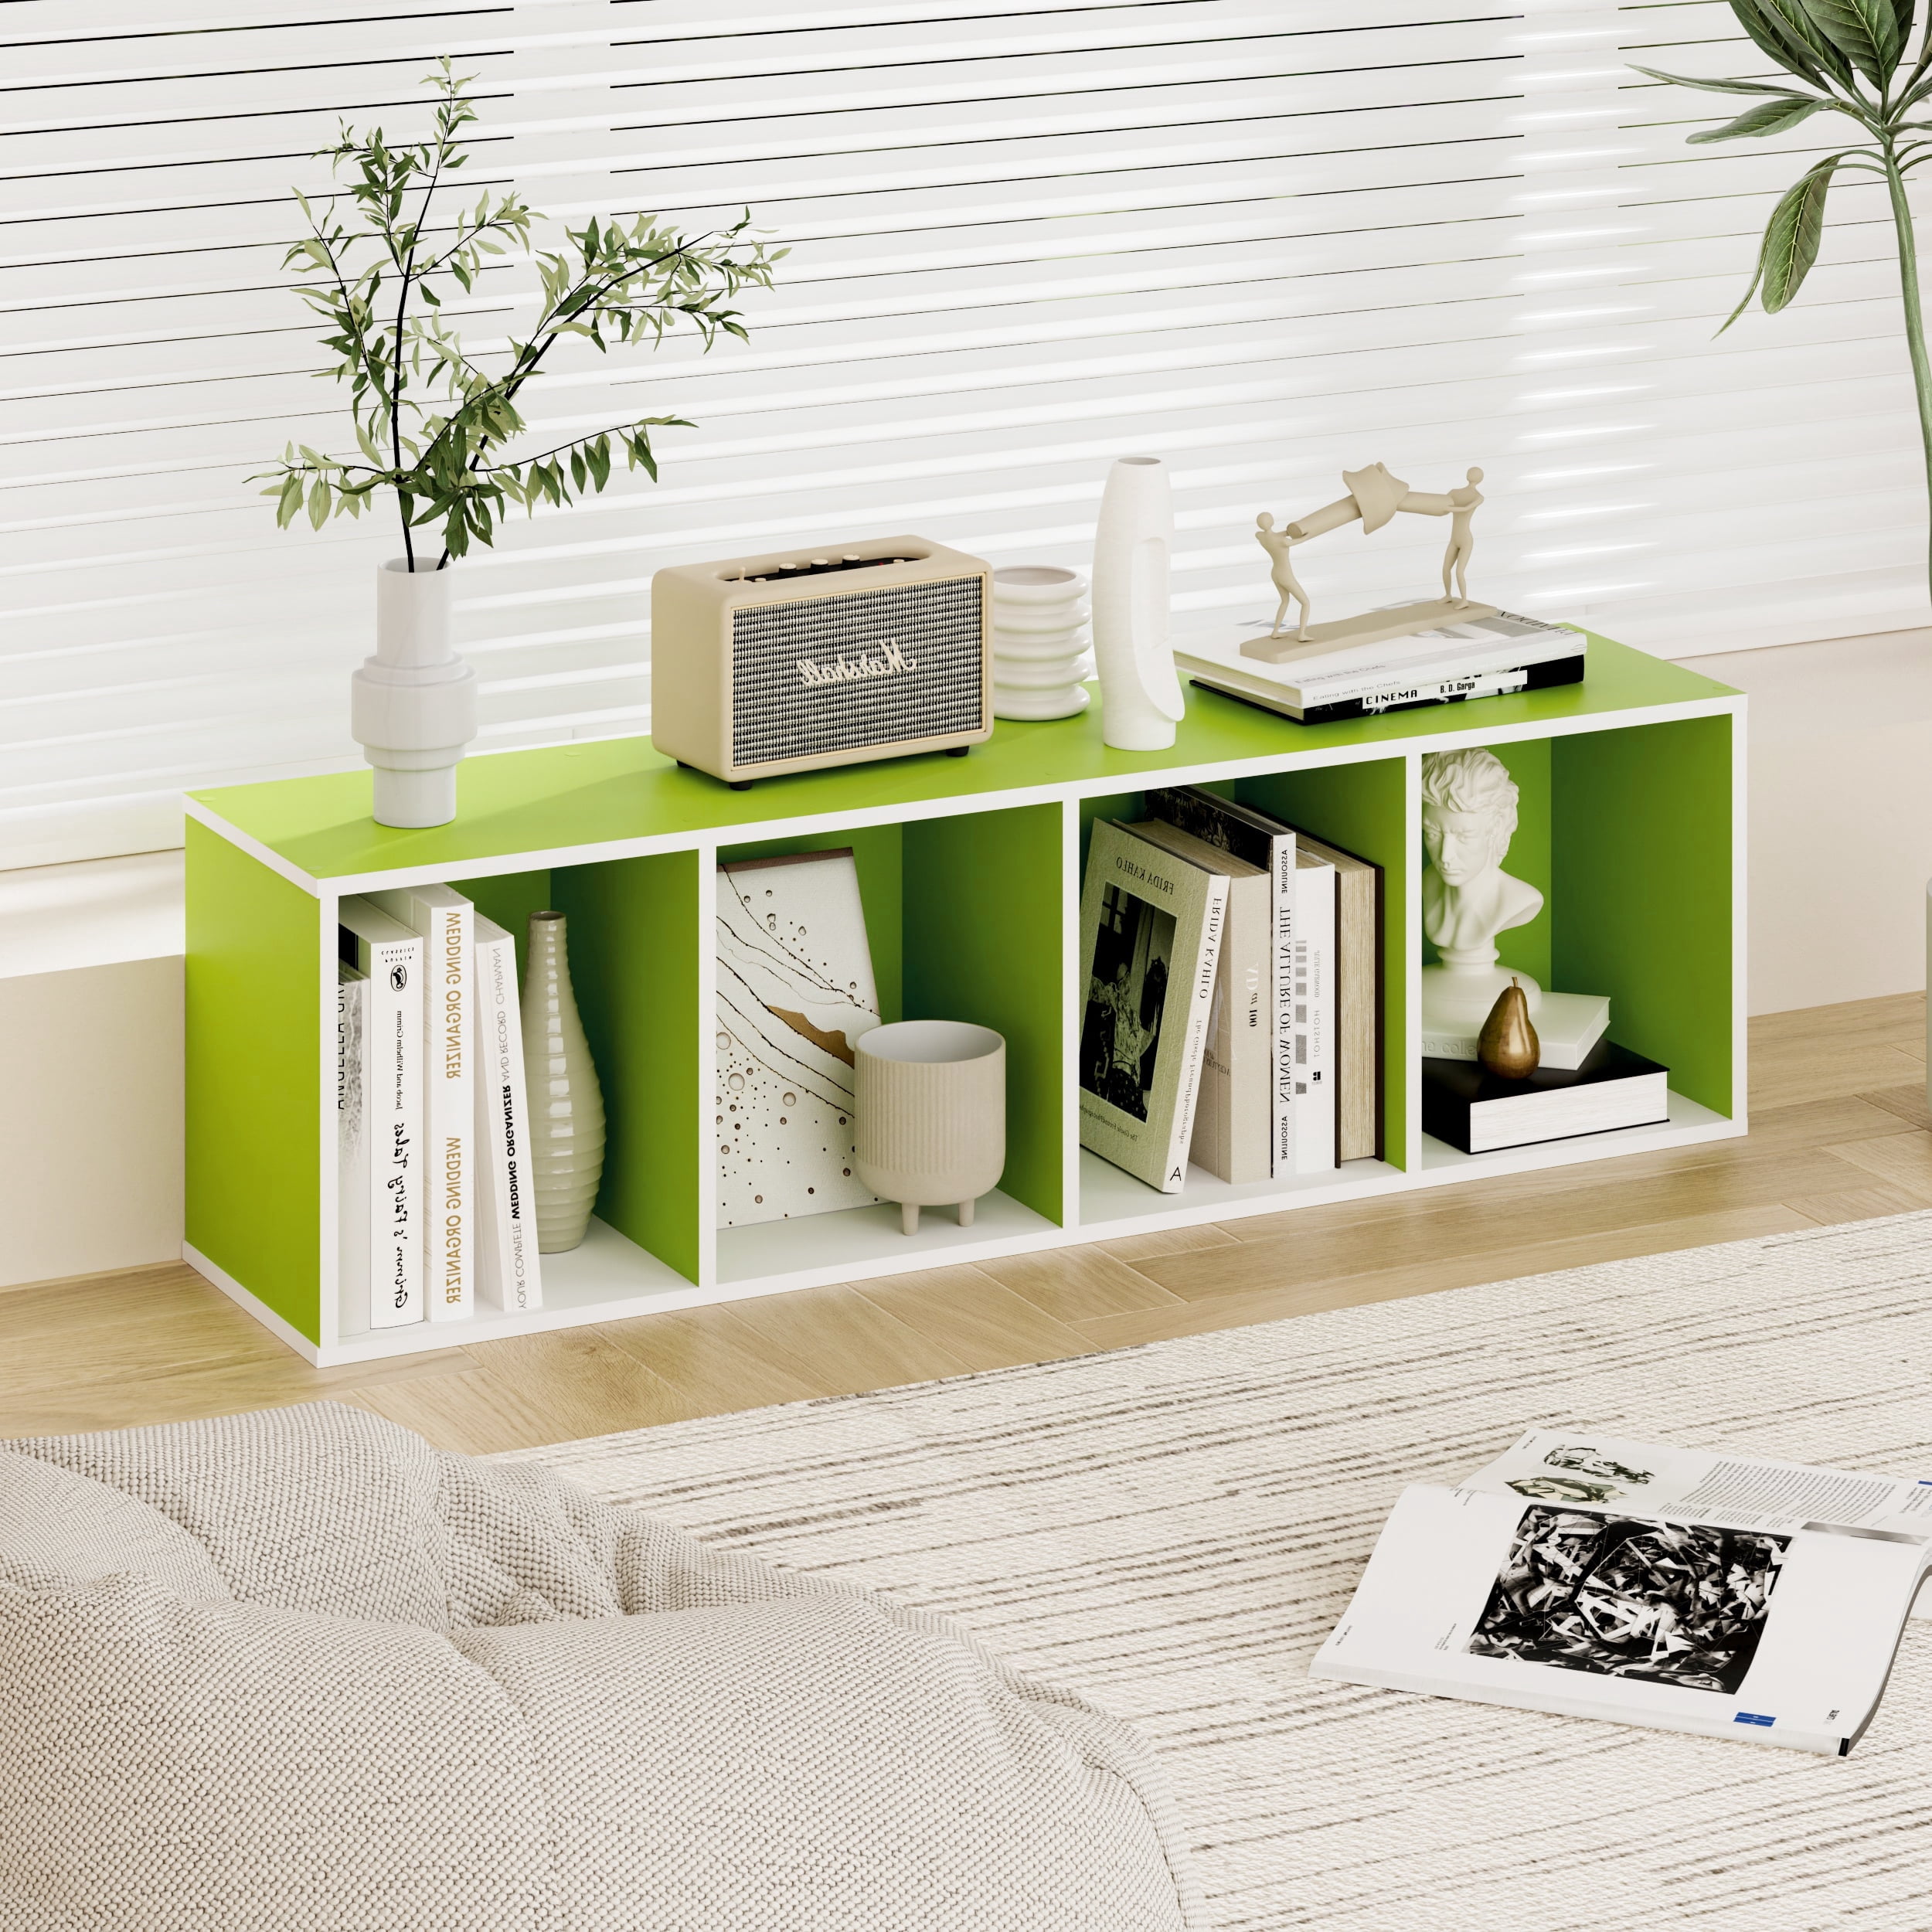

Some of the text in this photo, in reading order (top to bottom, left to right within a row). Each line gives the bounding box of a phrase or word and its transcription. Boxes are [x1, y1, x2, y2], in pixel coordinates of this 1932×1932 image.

[1312, 692, 1340, 701] Eating
[1376, 680, 1401, 689] Chefs
[1440, 680, 1475, 694] B. D. Garga
[1366, 689, 1418, 706] CINEMA
[1169, 1166, 1182, 1182] A
